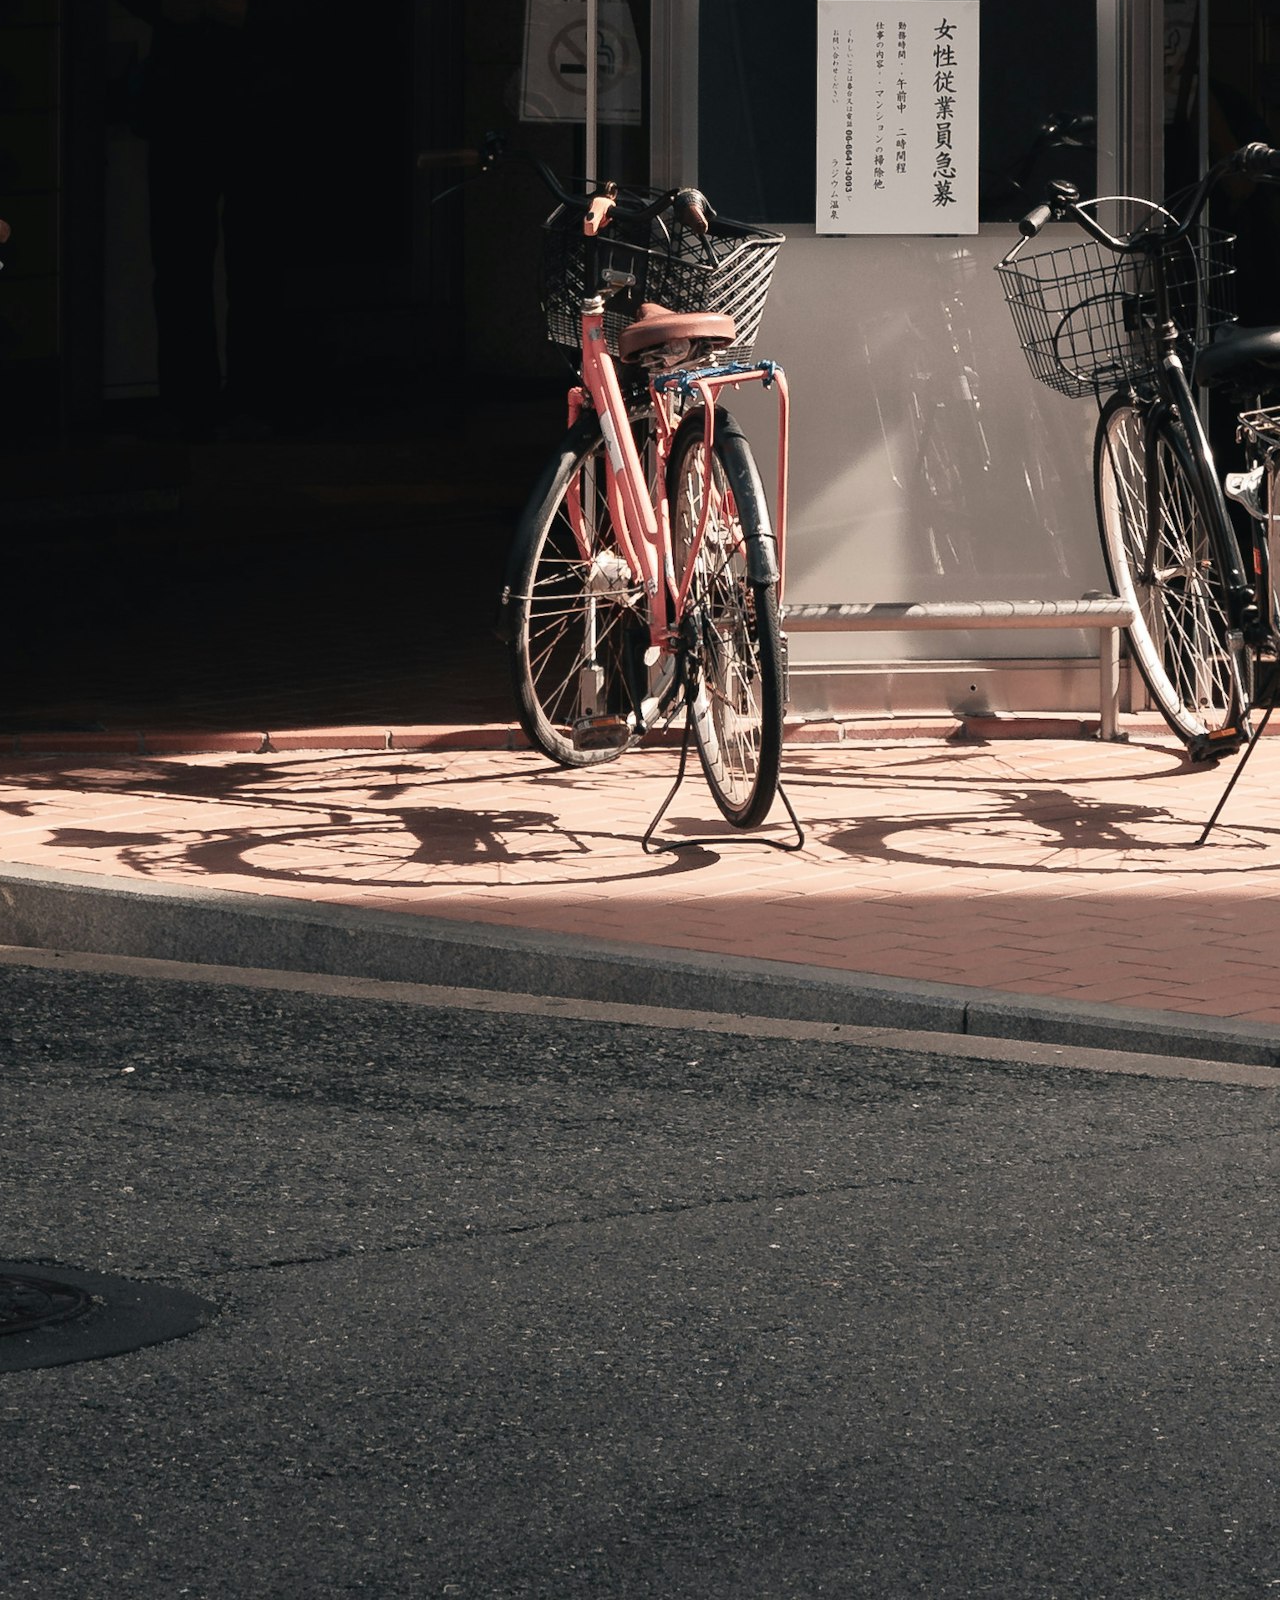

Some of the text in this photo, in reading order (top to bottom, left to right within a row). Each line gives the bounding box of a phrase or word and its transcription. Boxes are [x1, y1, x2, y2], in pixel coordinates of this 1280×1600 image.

[932, 17, 958, 208] 女性従業員急募
